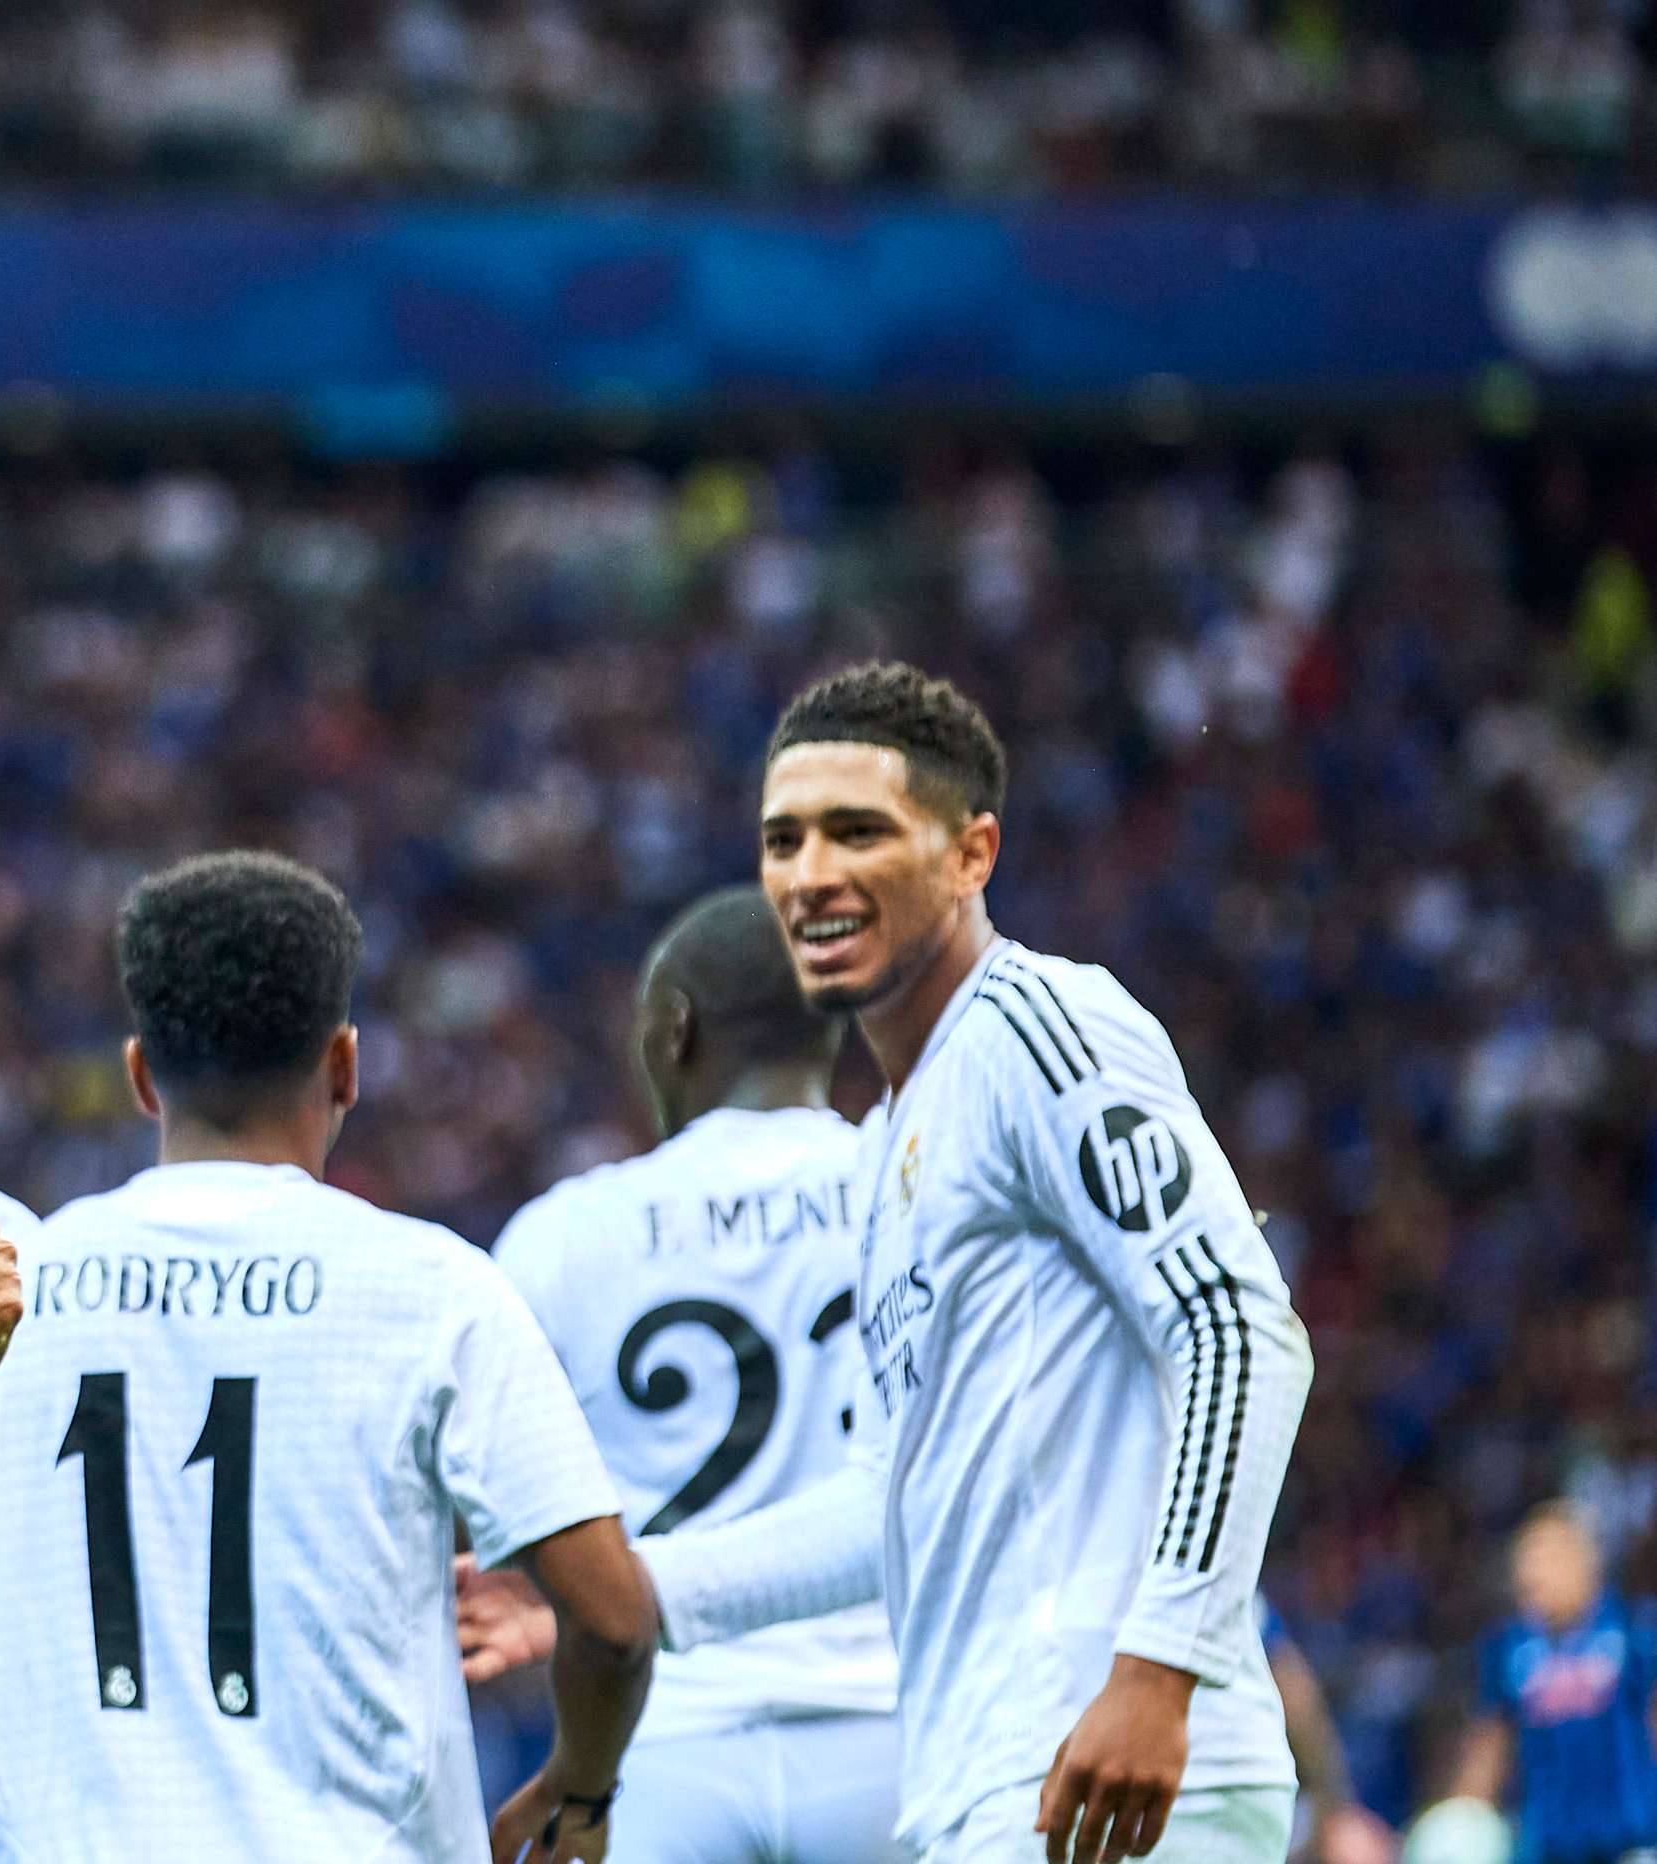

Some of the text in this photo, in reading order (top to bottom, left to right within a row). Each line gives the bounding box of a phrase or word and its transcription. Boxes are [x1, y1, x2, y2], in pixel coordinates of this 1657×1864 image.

[1088, 1109, 1179, 1231] hp
[34, 1255, 323, 1318] RODRYGO
[55, 1371, 260, 1718] 11
